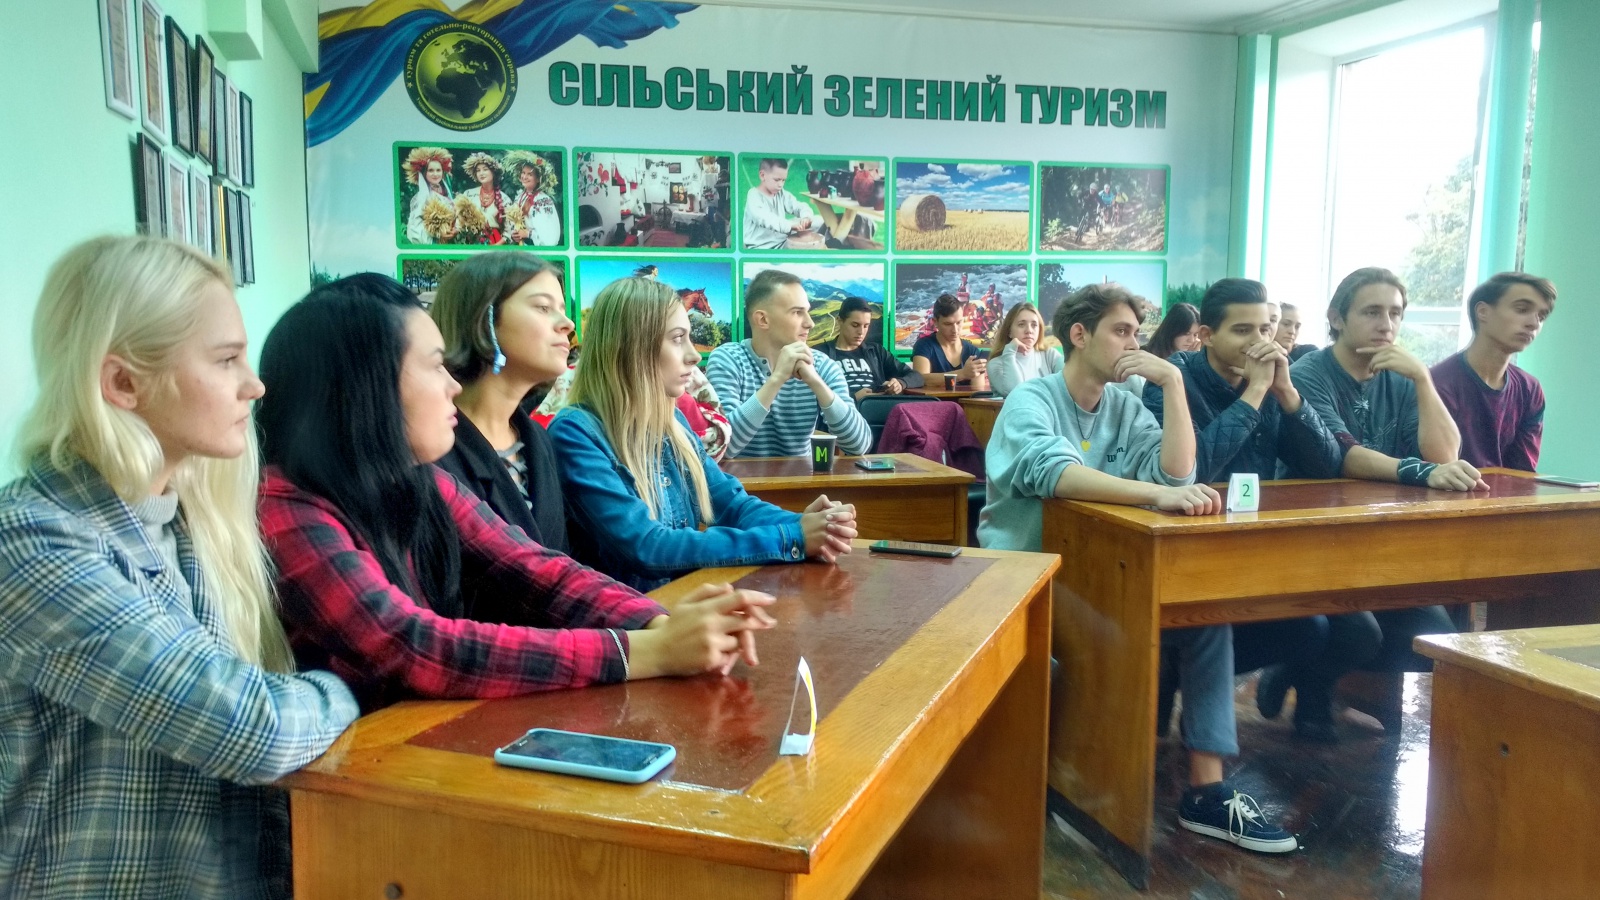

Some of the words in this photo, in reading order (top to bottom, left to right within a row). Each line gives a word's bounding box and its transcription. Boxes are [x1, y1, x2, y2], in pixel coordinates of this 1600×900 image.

[548, 61, 813, 115] СІЛЬСЬКИЙ
[824, 75, 1006, 122] ЗЕЛЕНИЙ
[1015, 84, 1167, 129] ТУРИЗМ
[815, 446, 828, 463] M
[1242, 483, 1251, 497] 2
